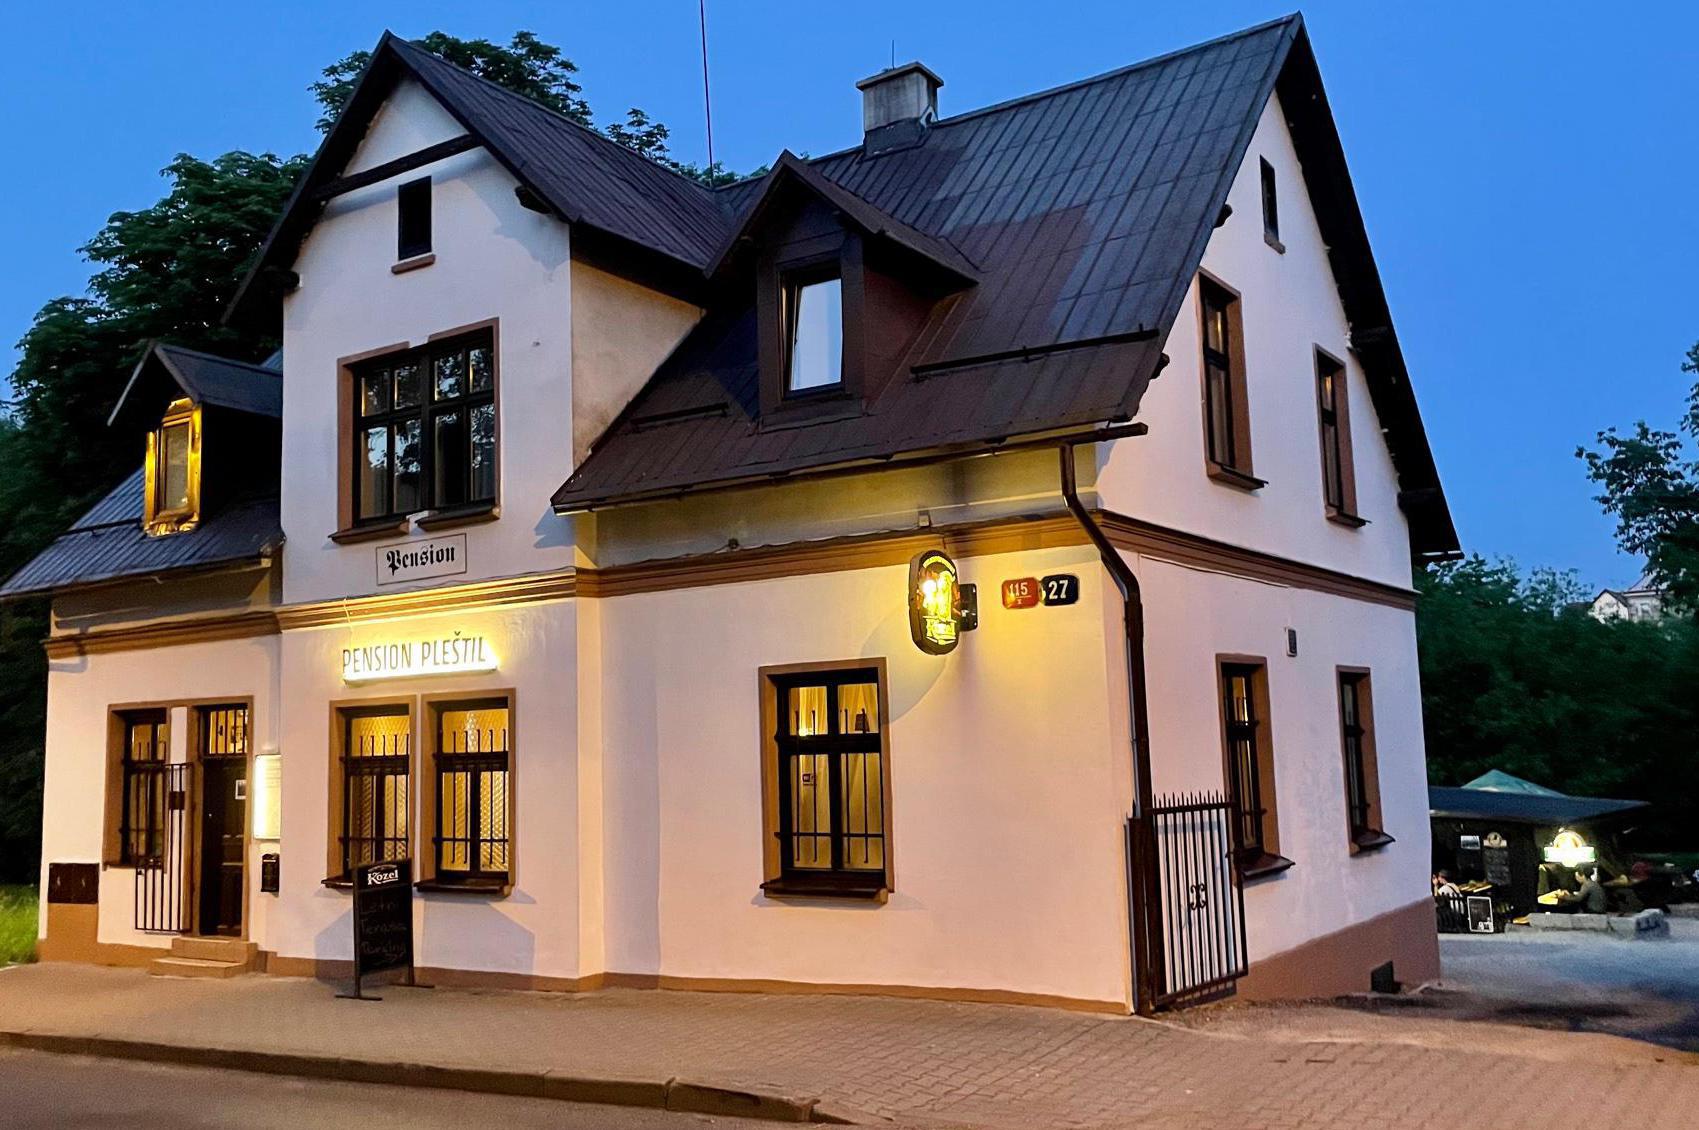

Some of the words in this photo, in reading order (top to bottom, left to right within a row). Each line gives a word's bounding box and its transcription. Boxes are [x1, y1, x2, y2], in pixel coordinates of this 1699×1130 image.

[386, 544, 455, 576] Pension
[1009, 582, 1028, 597] 115
[1048, 579, 1069, 600] 27
[342, 642, 412, 674] PENSION
[421, 630, 486, 667] PLEŠTIL
[367, 869, 399, 886] Kozel
